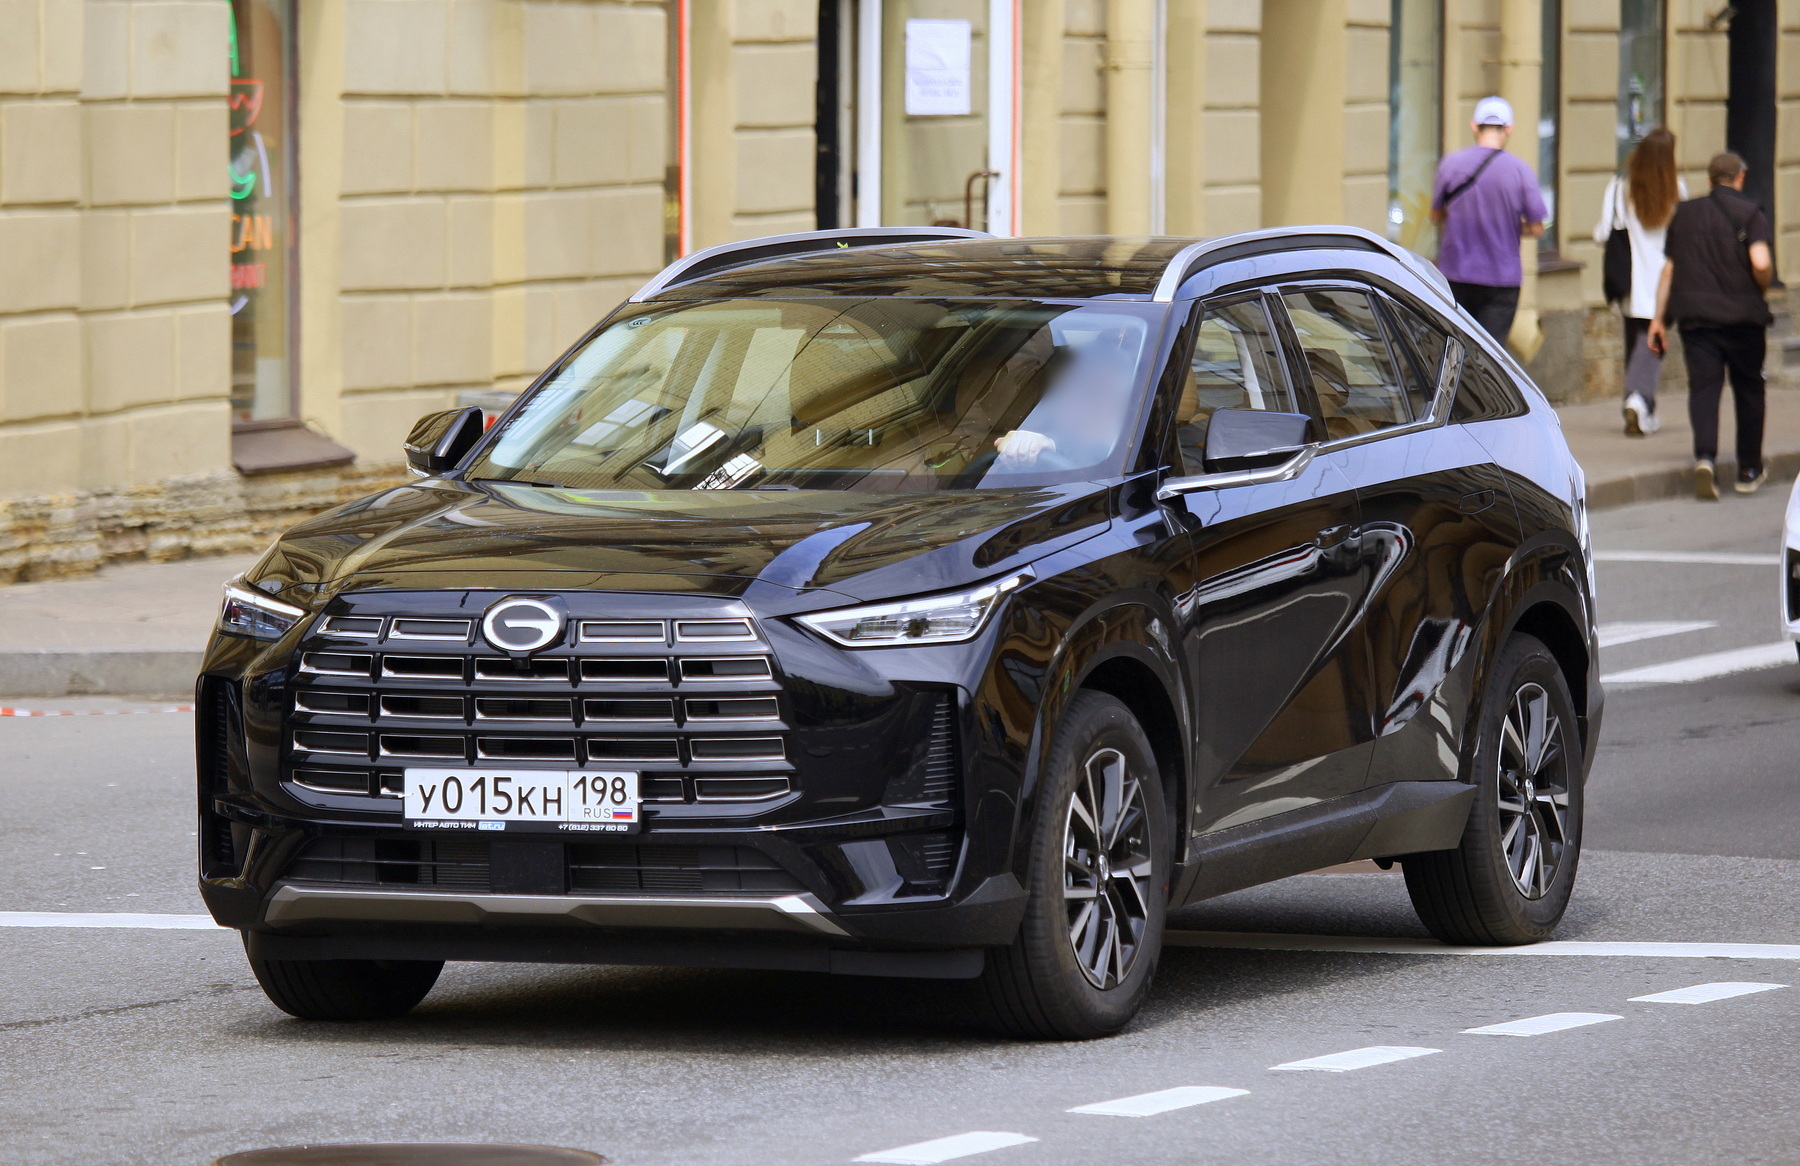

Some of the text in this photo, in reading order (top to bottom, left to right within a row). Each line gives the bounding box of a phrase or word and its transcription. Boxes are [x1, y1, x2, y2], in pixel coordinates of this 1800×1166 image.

[573, 775, 627, 806] 198
[584, 807, 611, 818] RUS
[558, 823, 568, 831] +7
[568, 823, 589, 832] (812)
